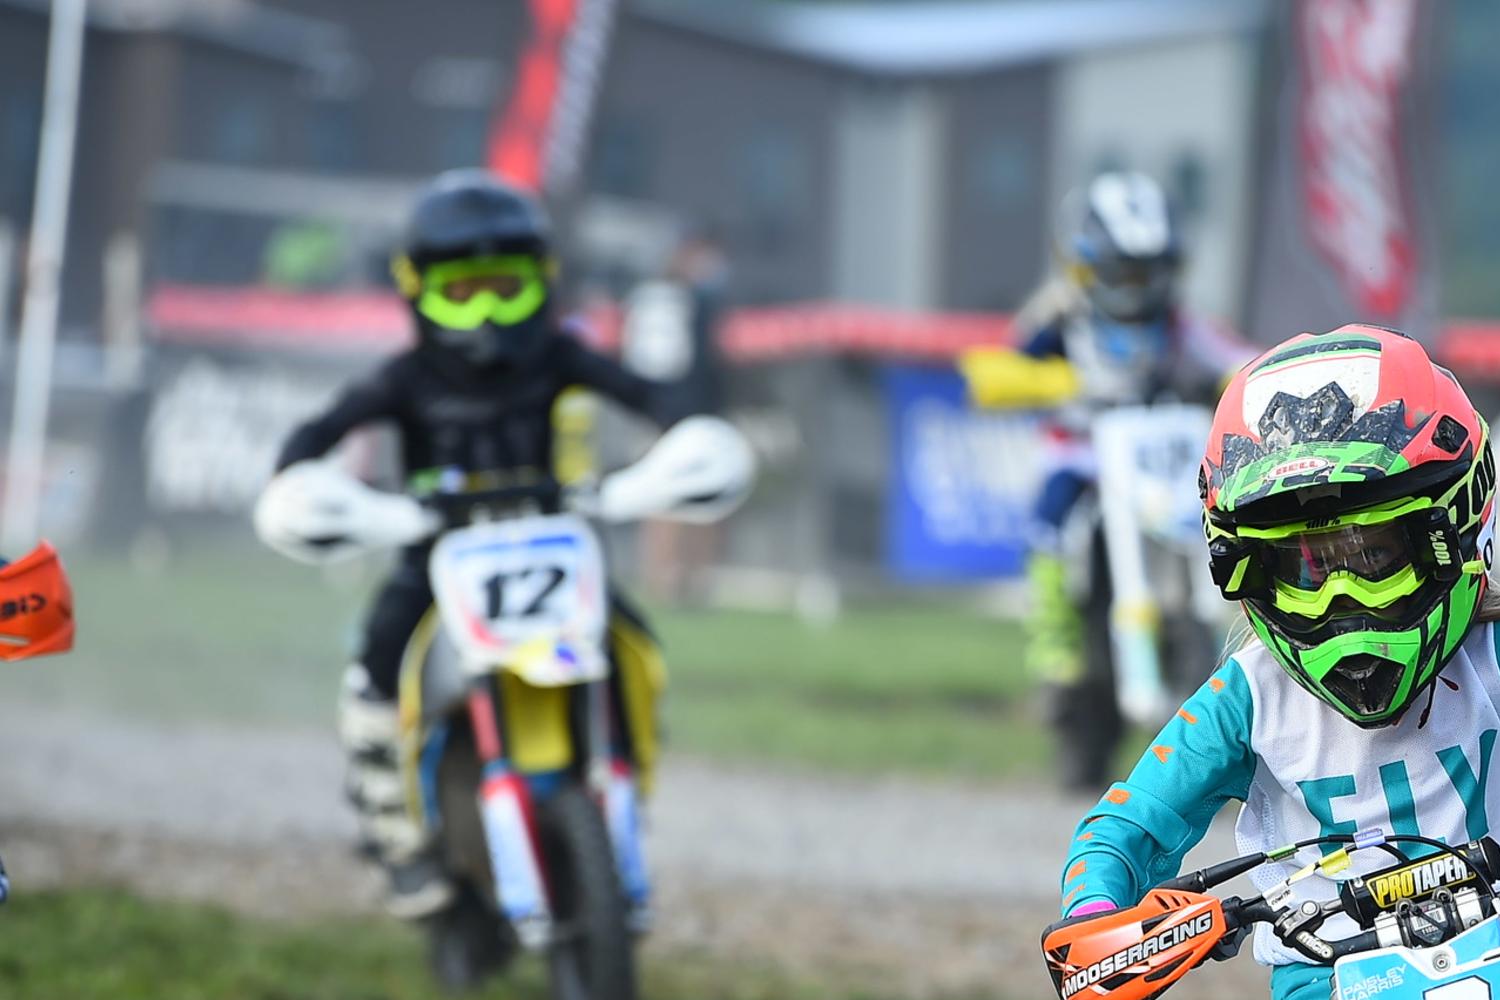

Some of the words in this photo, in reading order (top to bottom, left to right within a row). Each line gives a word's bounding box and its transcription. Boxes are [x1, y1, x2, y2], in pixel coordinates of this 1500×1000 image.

[1274, 457, 1320, 477] BELL
[1429, 529, 1452, 566] 100%
[1296, 729, 1498, 860] FLY
[1375, 856, 1468, 903] PROTAPER
[1064, 911, 1213, 998] MOOSERACING
[1343, 964, 1407, 995] PAISLEY
